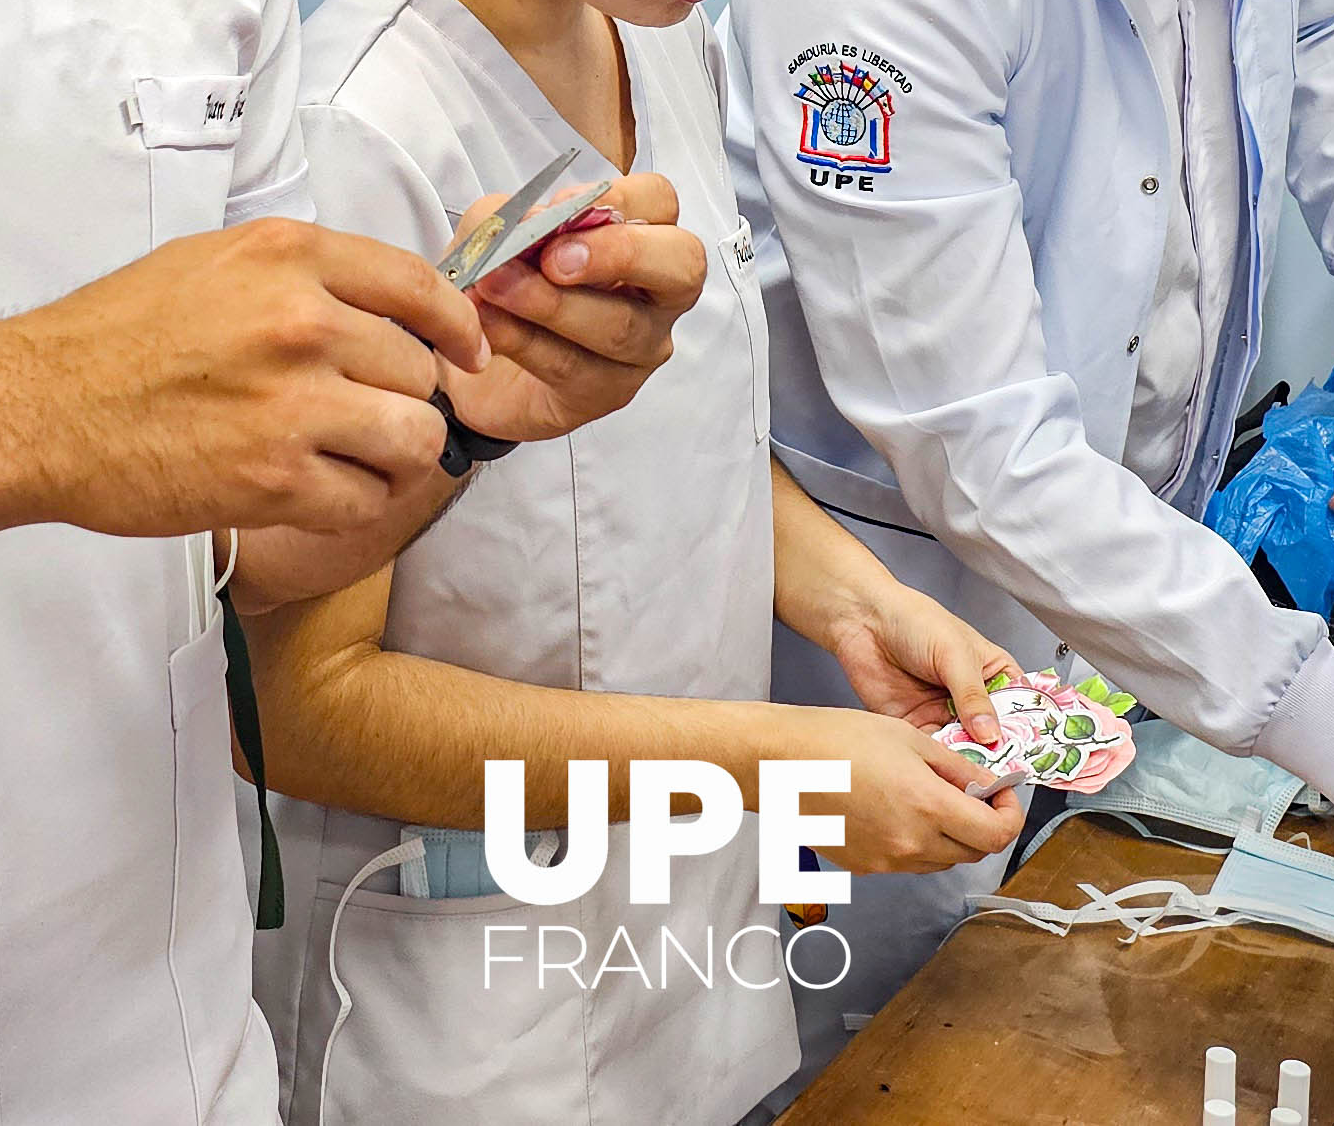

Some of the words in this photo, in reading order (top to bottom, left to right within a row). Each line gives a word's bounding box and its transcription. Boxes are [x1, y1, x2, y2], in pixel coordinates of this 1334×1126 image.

[788, 43, 838, 74] SABIDURIA
[842, 44, 858, 57] ES
[862, 49, 913, 93] LIBERTAD
[810, 168, 874, 192] UPE
